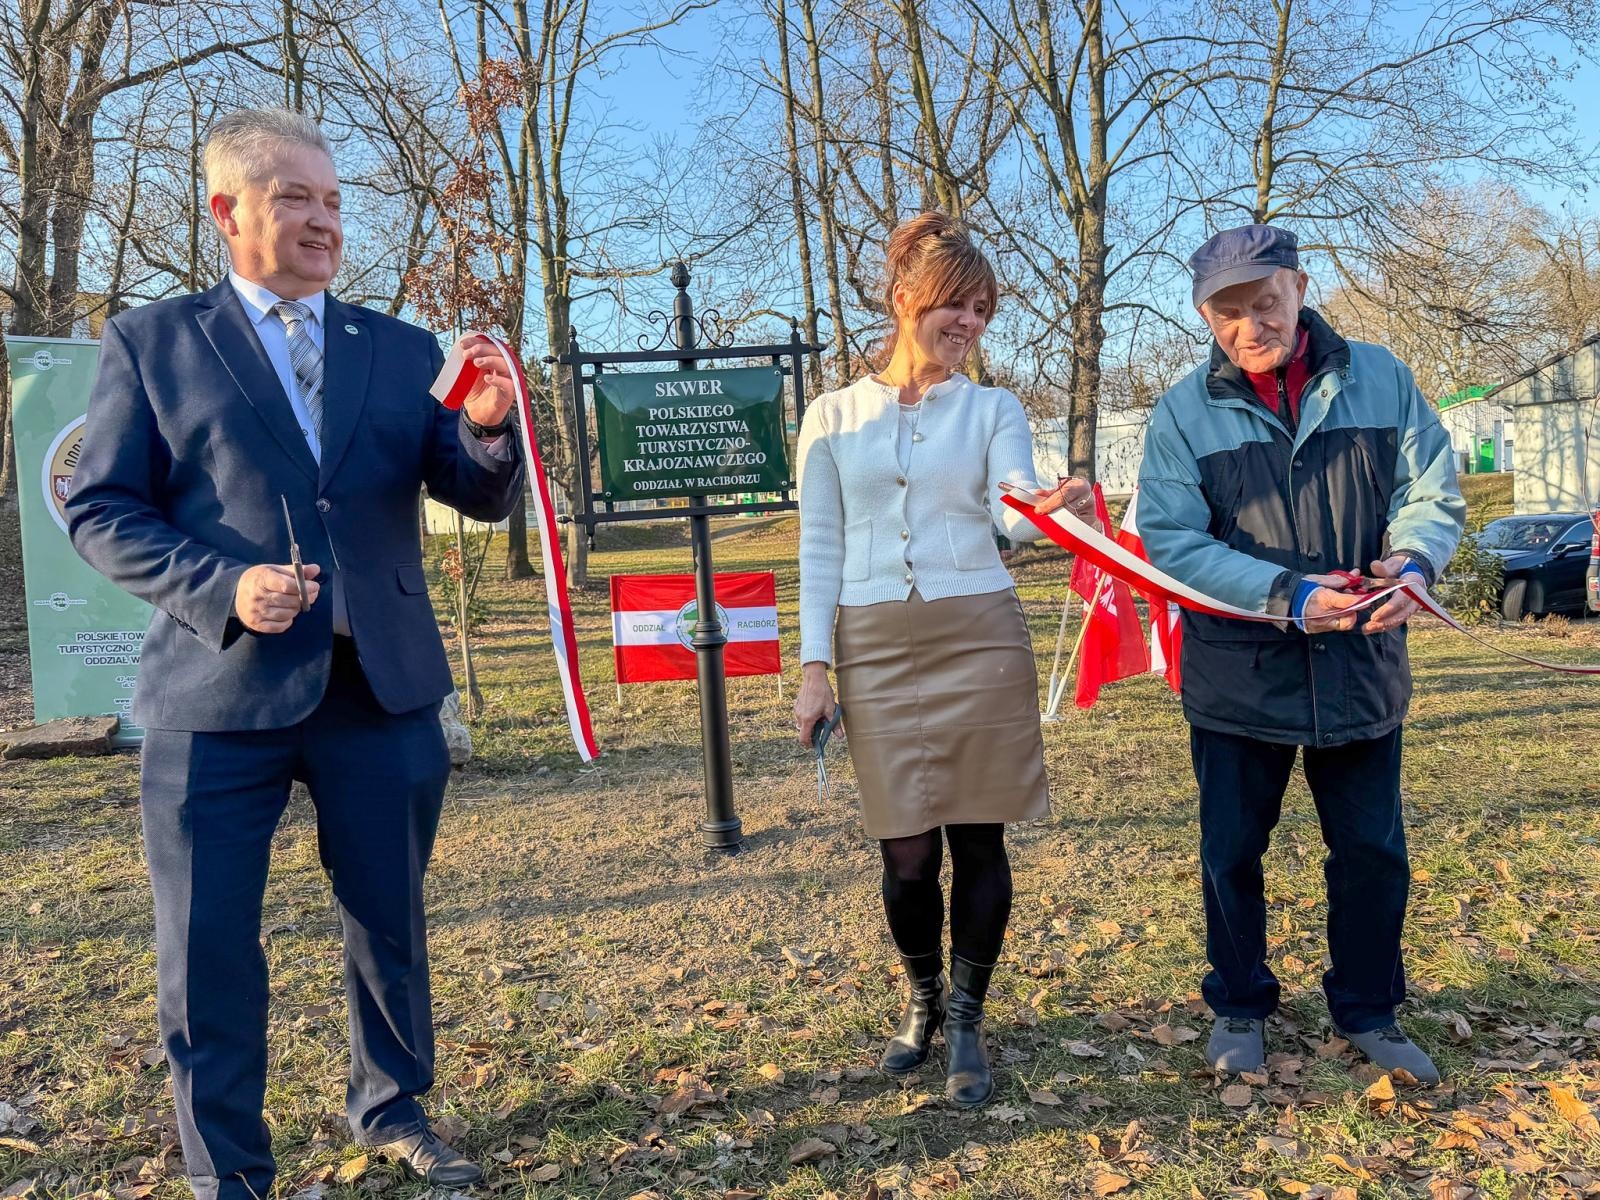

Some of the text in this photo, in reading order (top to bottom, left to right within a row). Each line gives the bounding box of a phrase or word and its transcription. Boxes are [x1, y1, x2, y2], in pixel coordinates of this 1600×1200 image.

[655, 379, 724, 397] SKWER
[648, 404, 735, 421] POLSKIEGO
[635, 420, 750, 438] TOWARZYSTWA
[637, 437, 751, 455] TURYSTYCZNO-
[623, 452, 767, 473] KRAJOZNAWCZEGO
[633, 474, 761, 491] ODDZIAŁ W RACIBORZU
[632, 624, 666, 633] ODDZIAŁ
[737, 619, 776, 629] RACIBÓRZ
[77, 633, 119, 641] POLSKIE
[59, 644, 134, 654] TURYSTYCZNO
[85, 656, 140, 665] ODDZIAŁ W
